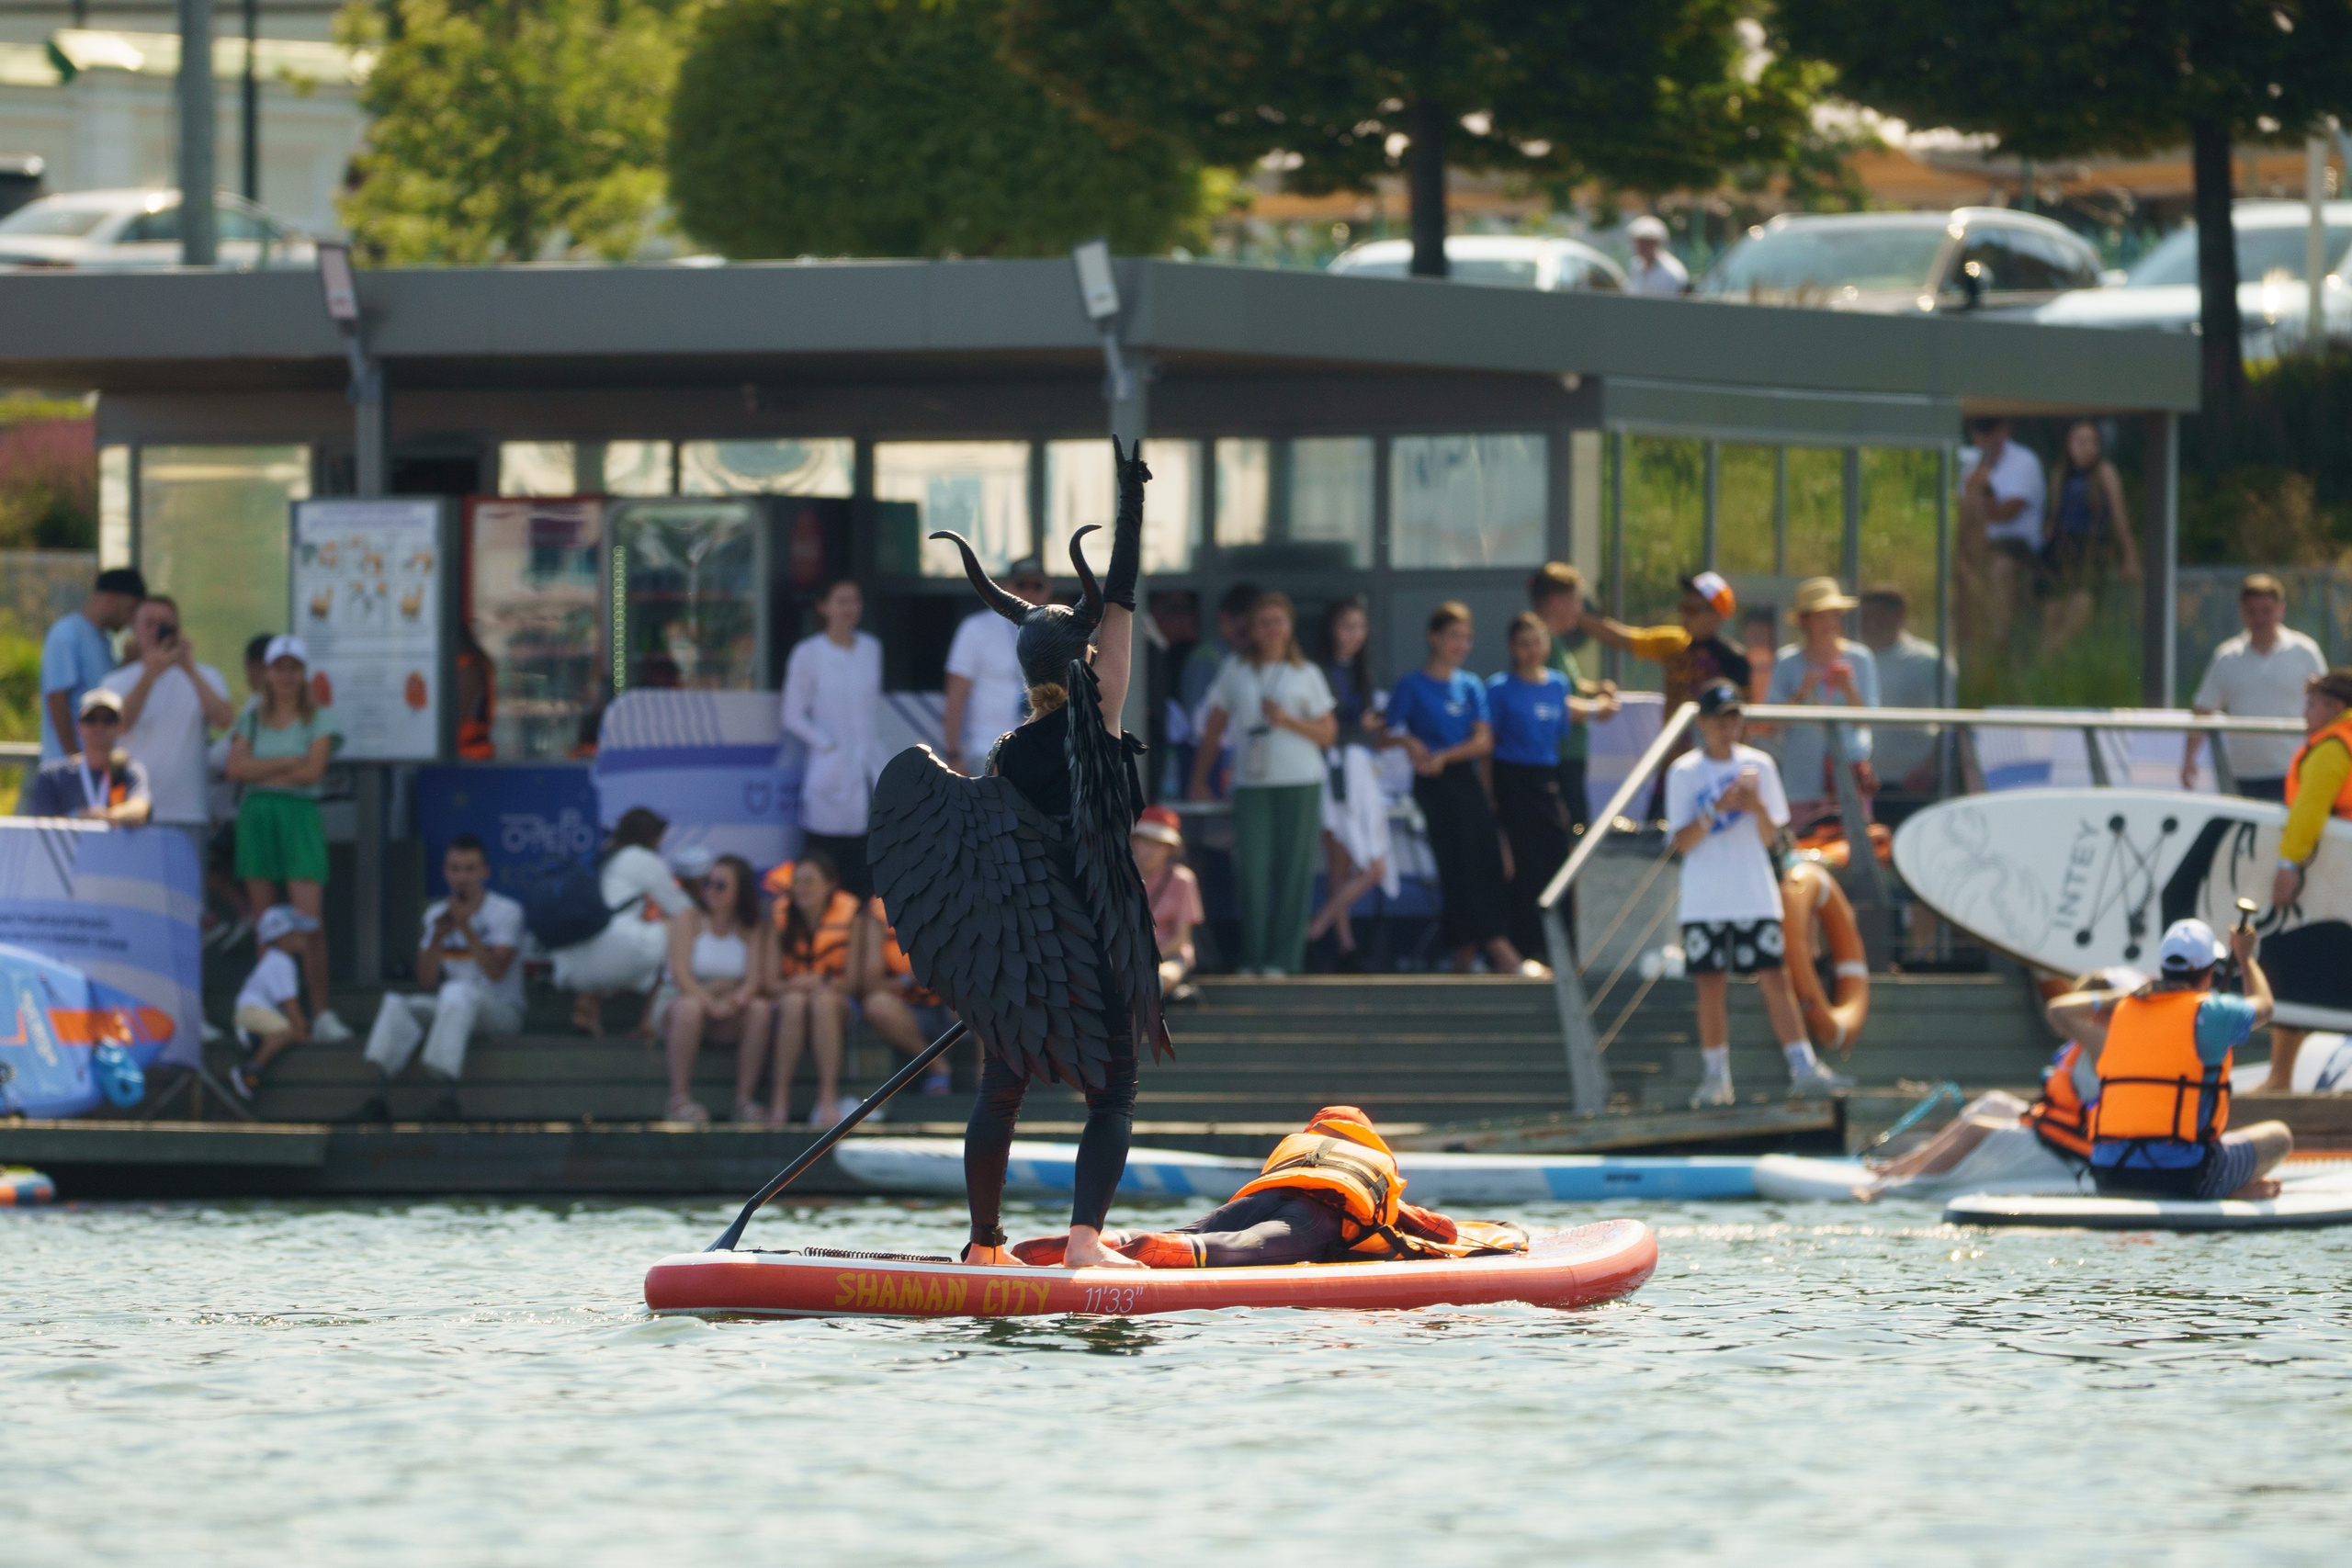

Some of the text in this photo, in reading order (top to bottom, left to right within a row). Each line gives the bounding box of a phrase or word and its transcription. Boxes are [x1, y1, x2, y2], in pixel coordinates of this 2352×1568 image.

[2052, 818, 2099, 930] INTEY
[834, 1271, 1050, 1314] SHAMAN CITY
